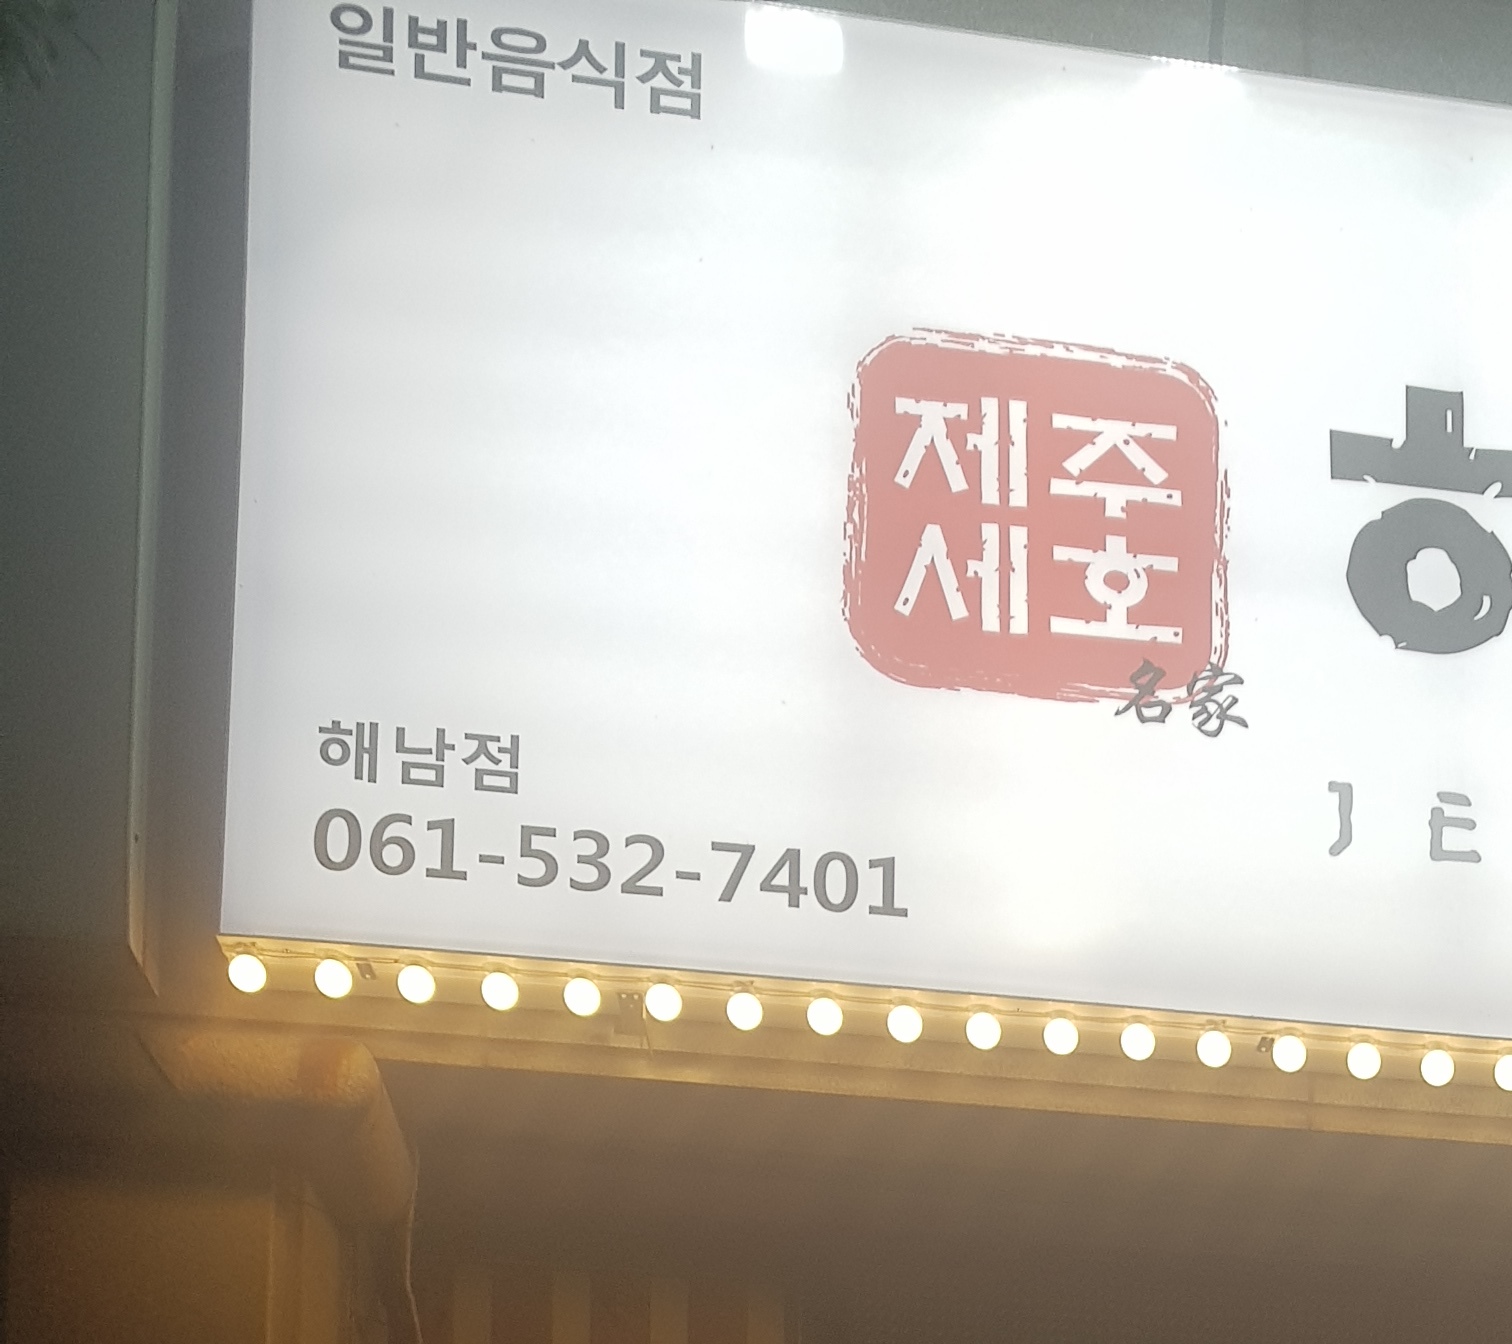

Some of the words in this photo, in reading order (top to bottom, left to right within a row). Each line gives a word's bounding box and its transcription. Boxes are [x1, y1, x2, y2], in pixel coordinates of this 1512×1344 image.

[328, 1, 703, 121] 일반음식점
[892, 395, 1183, 519] 제주
[892, 521, 1184, 646] 세호
[1114, 657, 1250, 738] 名家
[317, 718, 521, 796] 해남점
[312, 806, 910, 919] 061-532-7401
